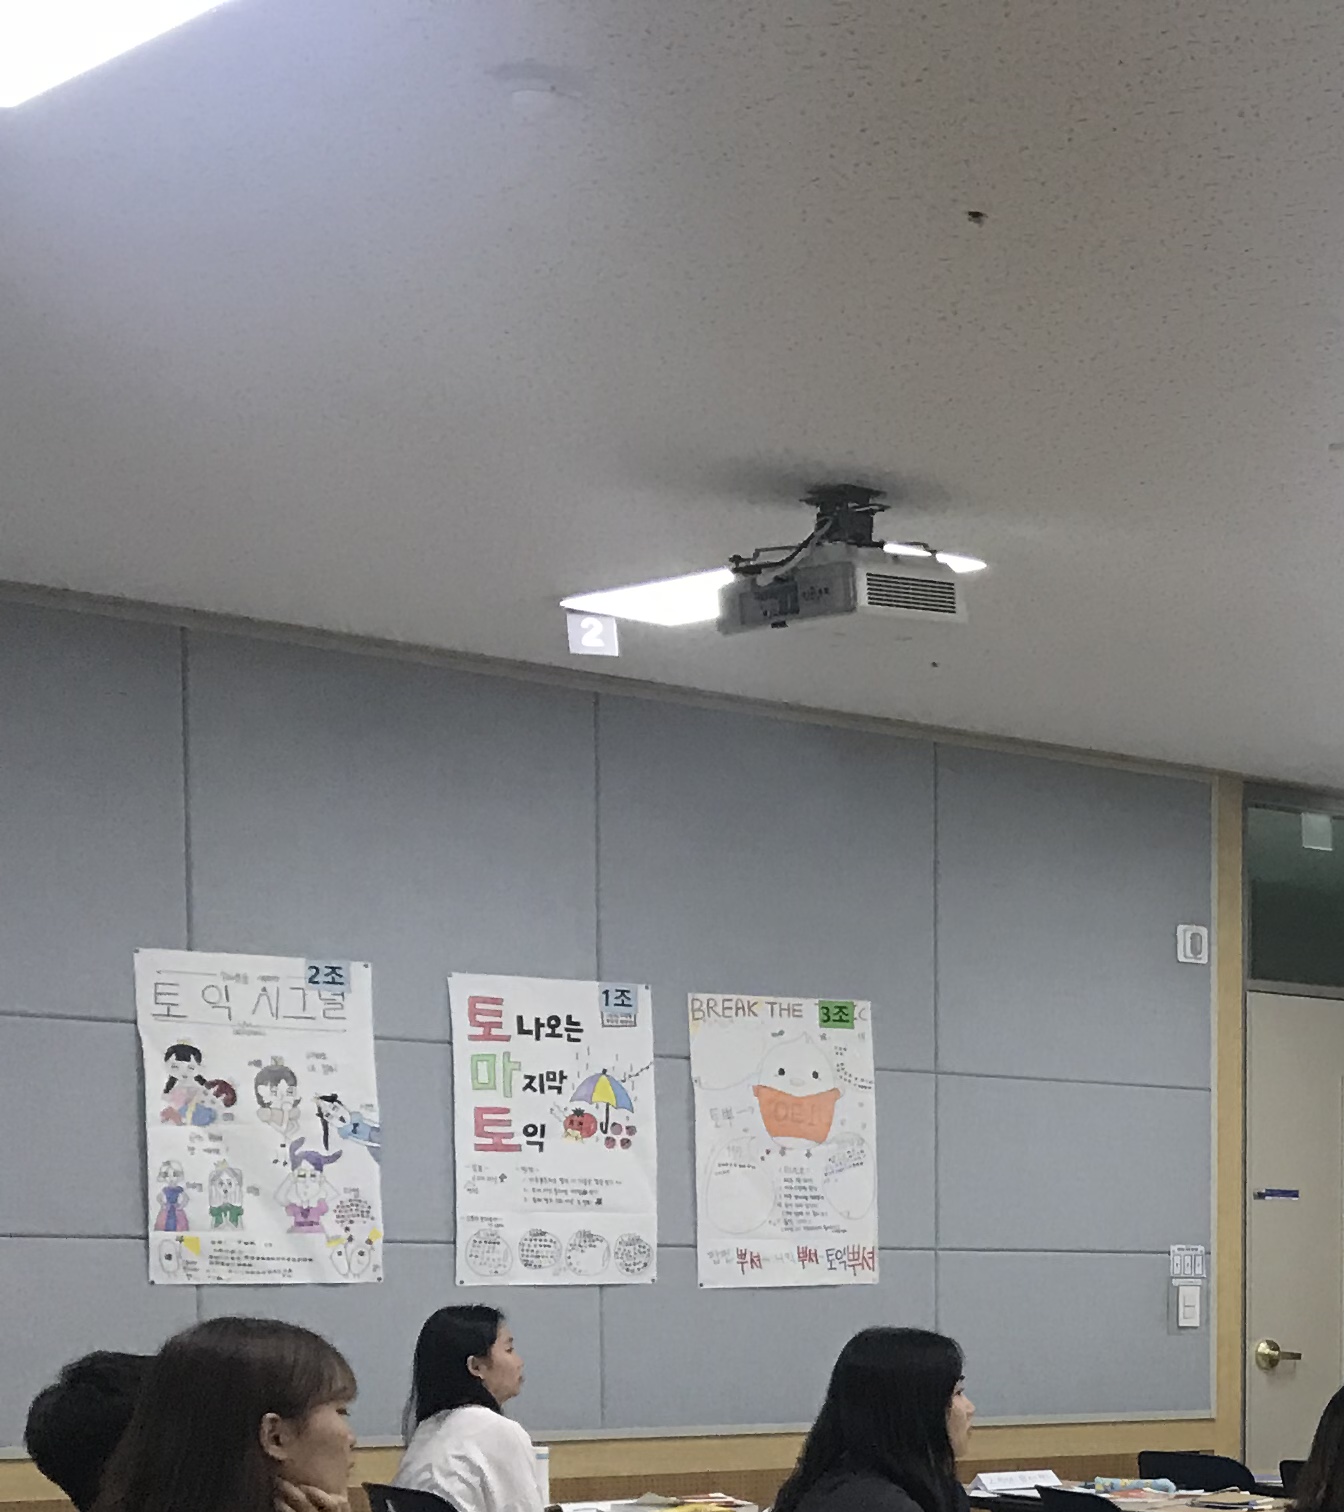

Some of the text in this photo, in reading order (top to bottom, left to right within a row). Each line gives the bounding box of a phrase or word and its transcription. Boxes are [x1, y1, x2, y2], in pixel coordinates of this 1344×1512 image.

[580, 617, 605, 647] 2
[307, 965, 345, 987] 2조
[602, 988, 634, 1008] 1조
[691, 998, 759, 1021] BREAK
[765, 1001, 804, 1019] THE
[820, 1005, 851, 1023] 3조
